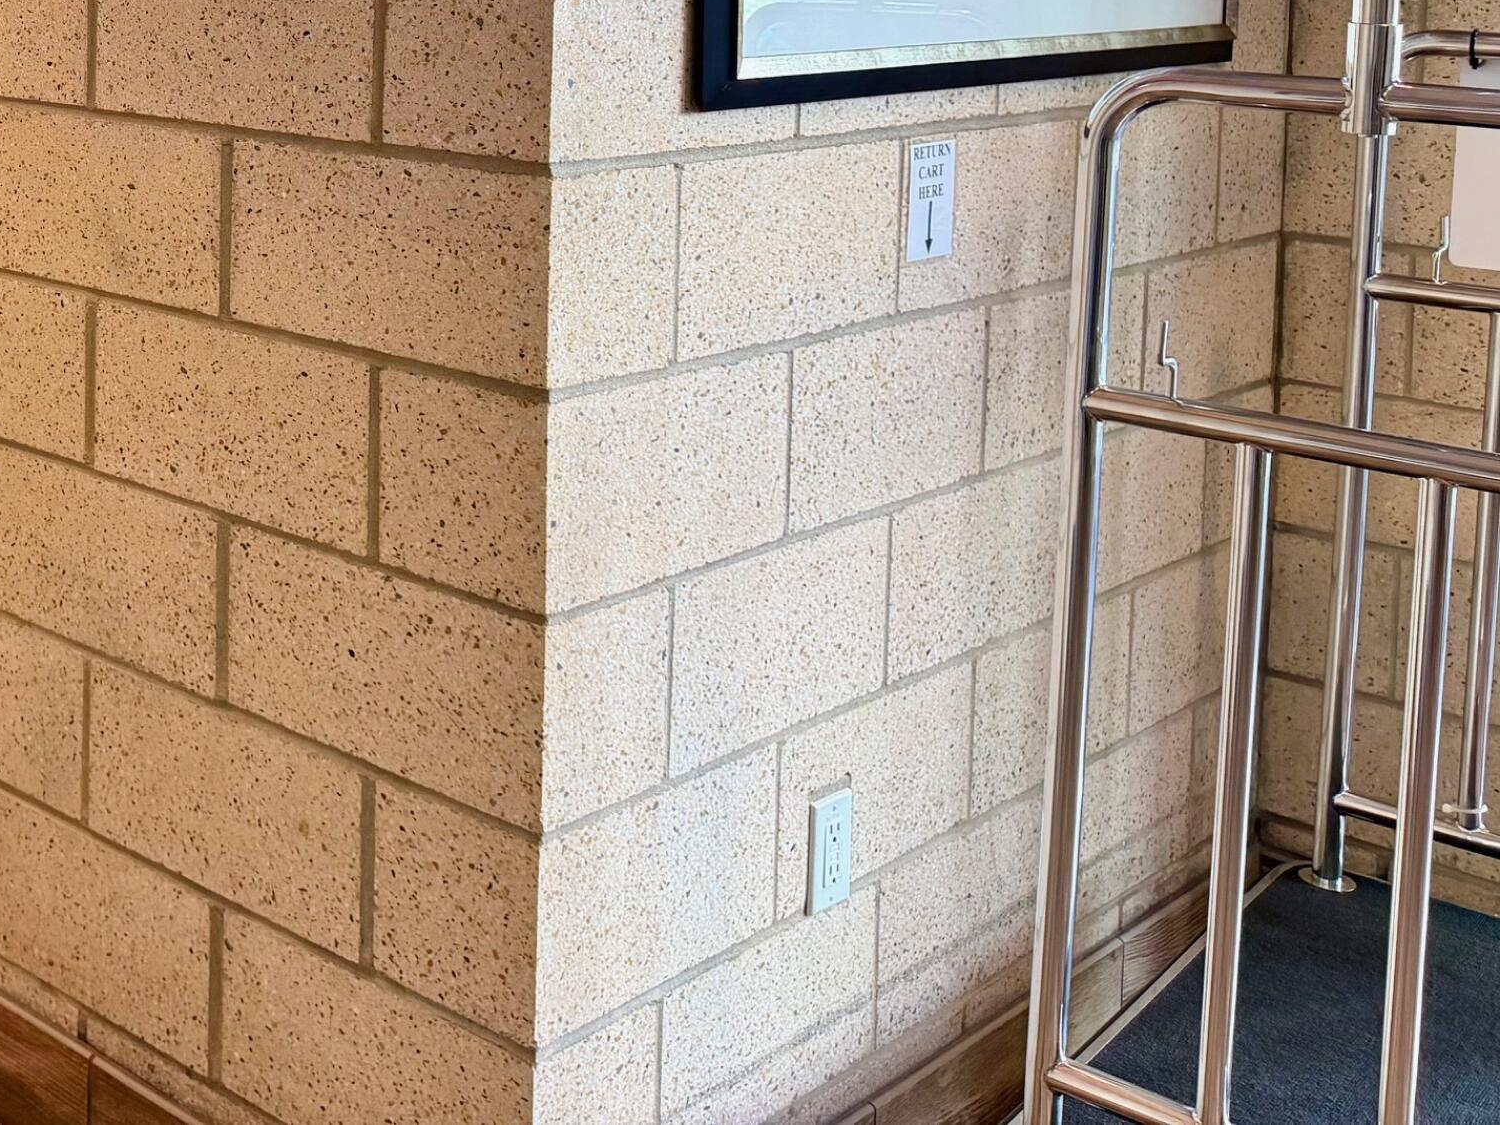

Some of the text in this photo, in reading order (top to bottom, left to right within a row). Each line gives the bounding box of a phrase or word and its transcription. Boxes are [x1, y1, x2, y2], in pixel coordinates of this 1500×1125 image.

[913, 143, 952, 161] RETURN
[918, 163, 945, 179] CART
[918, 183, 945, 200] HERE
